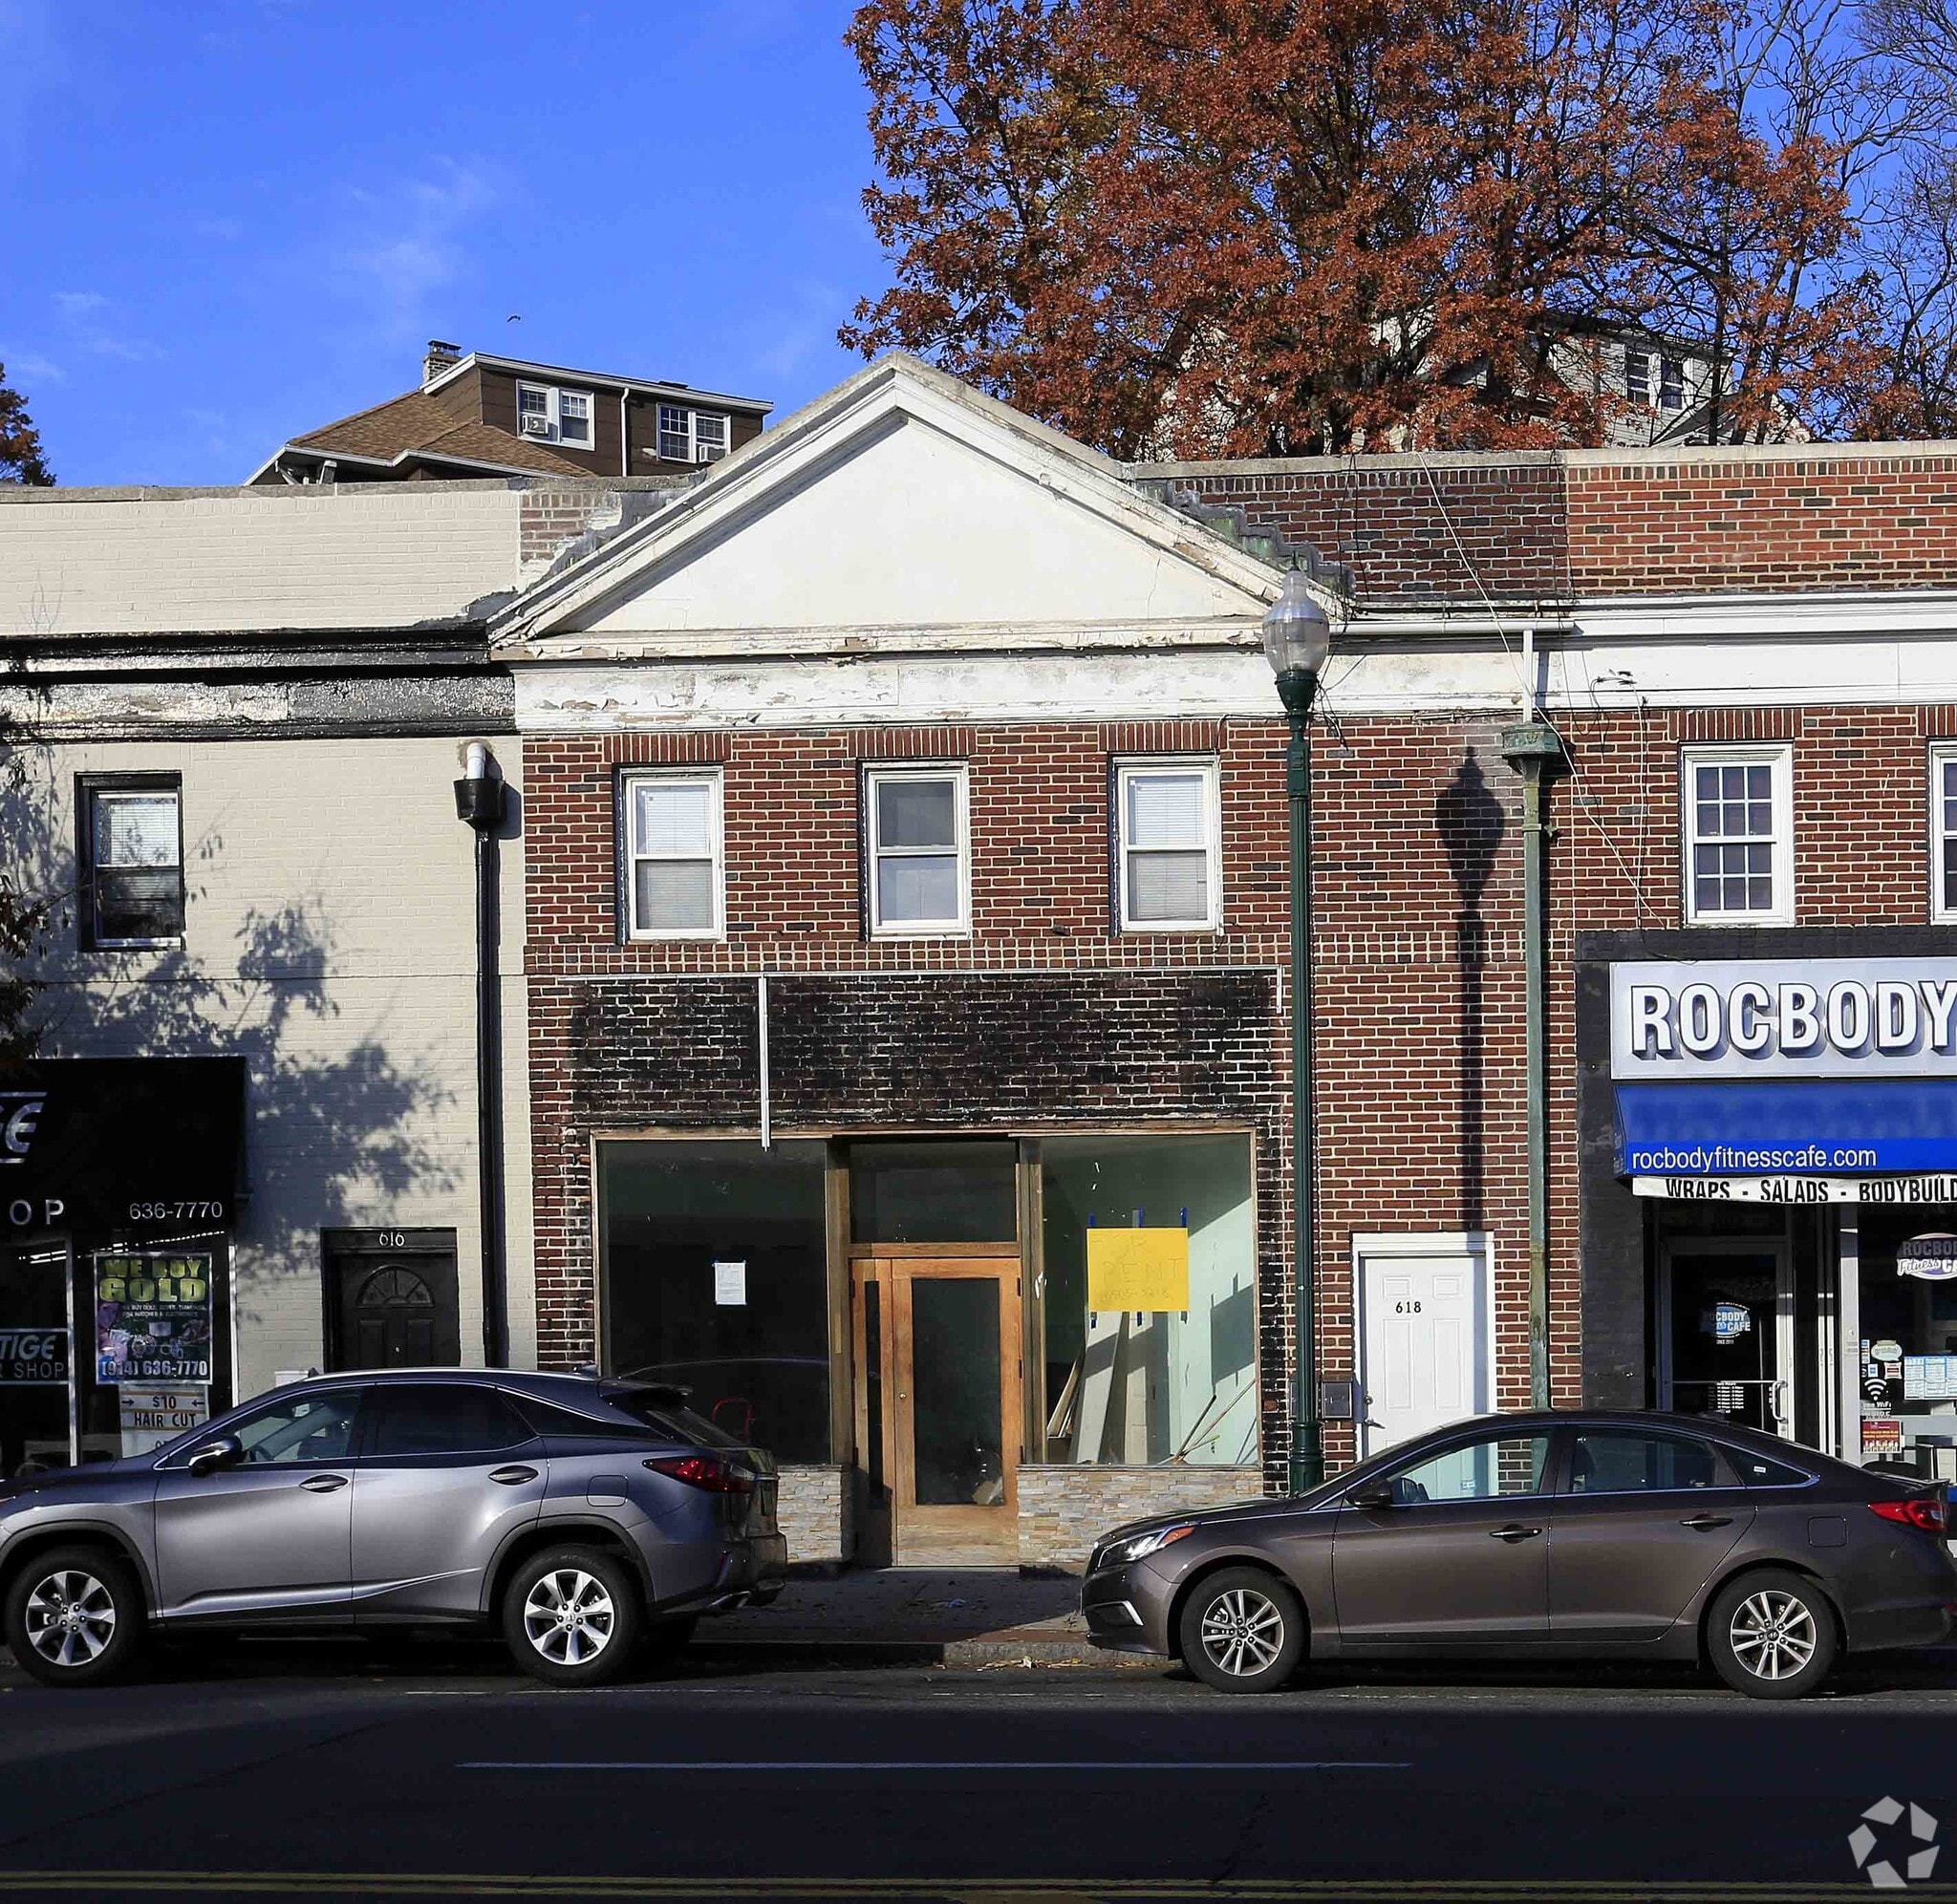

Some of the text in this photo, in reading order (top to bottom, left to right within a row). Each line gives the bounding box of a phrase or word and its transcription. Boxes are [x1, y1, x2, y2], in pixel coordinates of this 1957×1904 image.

[1631, 980, 1957, 1057] ROCBODY
[1632, 1145, 1877, 1173] rocbodyfitnesscafe.com
[1665, 1178, 1731, 1198] WRAPS
[1760, 1179, 1829, 1202] SALADS
[129, 1202, 224, 1219] 636-7770
[378, 1231, 405, 1246] 616
[104, 1259, 143, 1277] WE
[99, 1278, 206, 1302] GOLD
[1395, 1300, 1422, 1314] 618
[1727, 1322, 1751, 1332] CAFE
[14, 1361, 65, 1379] SHOP
[101, 1360, 208, 1376] (914) 636-7770
[135, 1413, 197, 1427] HAIR CUT
